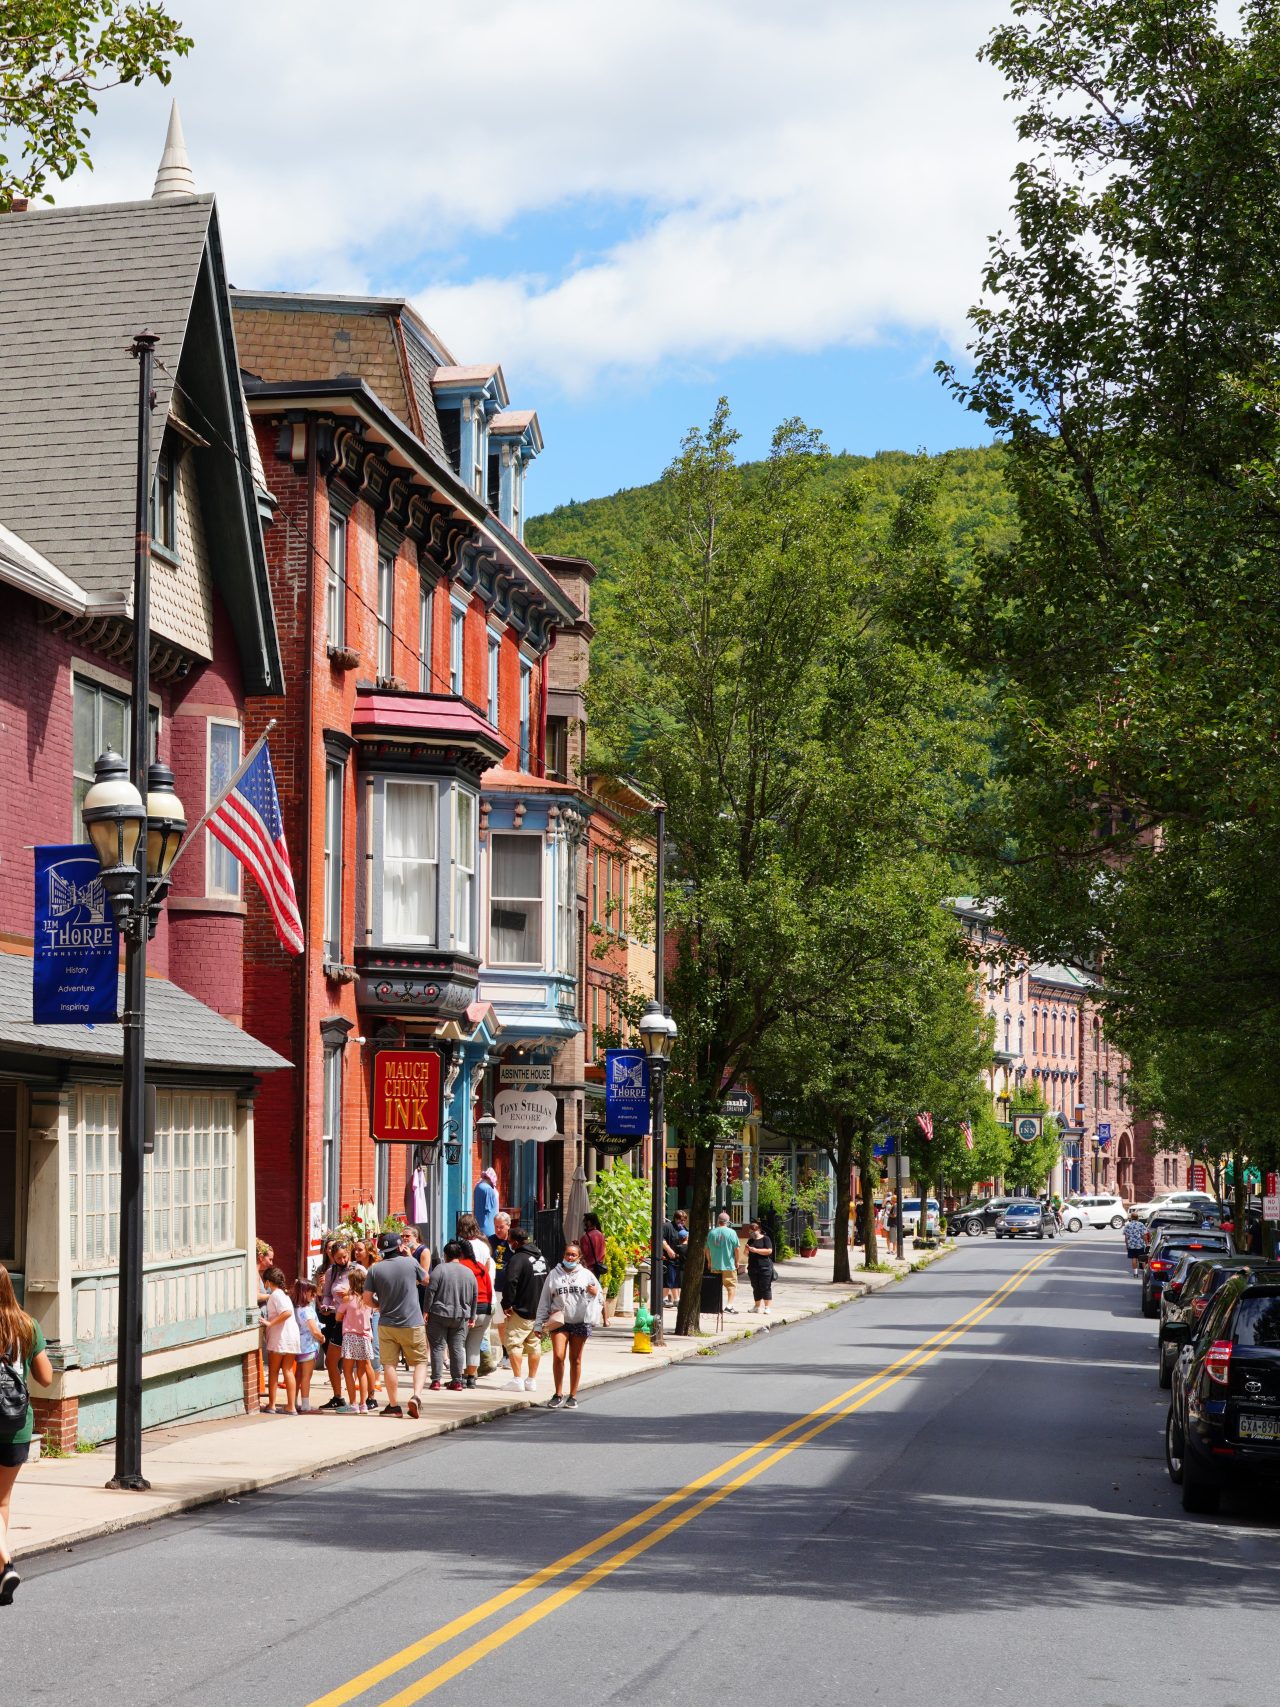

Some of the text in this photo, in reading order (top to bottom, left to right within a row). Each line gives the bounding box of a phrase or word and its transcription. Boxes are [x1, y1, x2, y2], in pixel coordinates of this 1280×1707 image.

[42, 920, 59, 931] JIM
[46, 921, 112, 949] THORPE
[65, 966, 89, 975] History
[57, 985, 96, 993] Adventure
[60, 1003, 90, 1012] Inspiring
[384, 1061, 429, 1080] MAUCH
[501, 1069, 551, 1080] ABSINTHE HOUSE
[384, 1079, 429, 1098] CHUNK
[611, 1085, 647, 1099] THORPE
[725, 1099, 748, 1107] ault
[384, 1097, 428, 1130] INK
[500, 1102, 519, 1116] TONY
[510, 1113, 541, 1122] ENCORE
[595, 1134, 627, 1144] House
